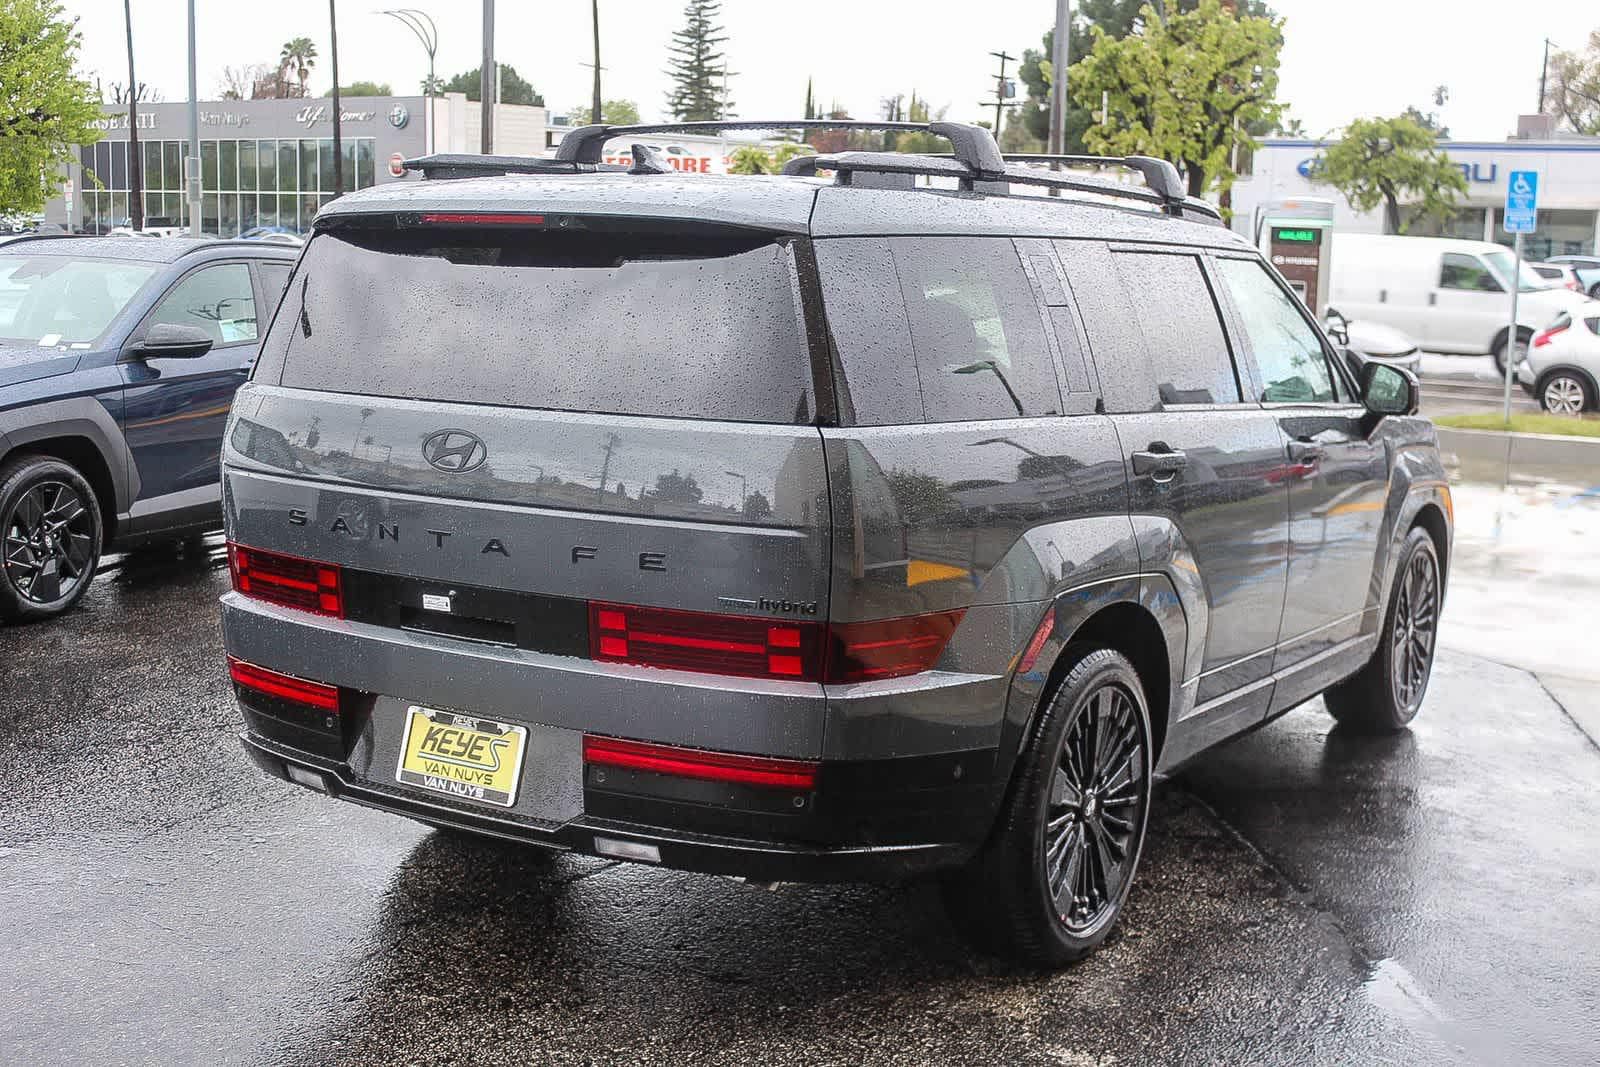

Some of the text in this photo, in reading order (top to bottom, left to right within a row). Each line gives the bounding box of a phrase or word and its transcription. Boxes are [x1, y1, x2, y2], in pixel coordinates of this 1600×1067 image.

[288, 508, 667, 573] SANTA FE
[759, 596, 817, 616] hybrid
[420, 726, 511, 771] KEYES
[424, 761, 494, 786] VAN NUYS
[423, 775, 485, 799] VAN NUYS
